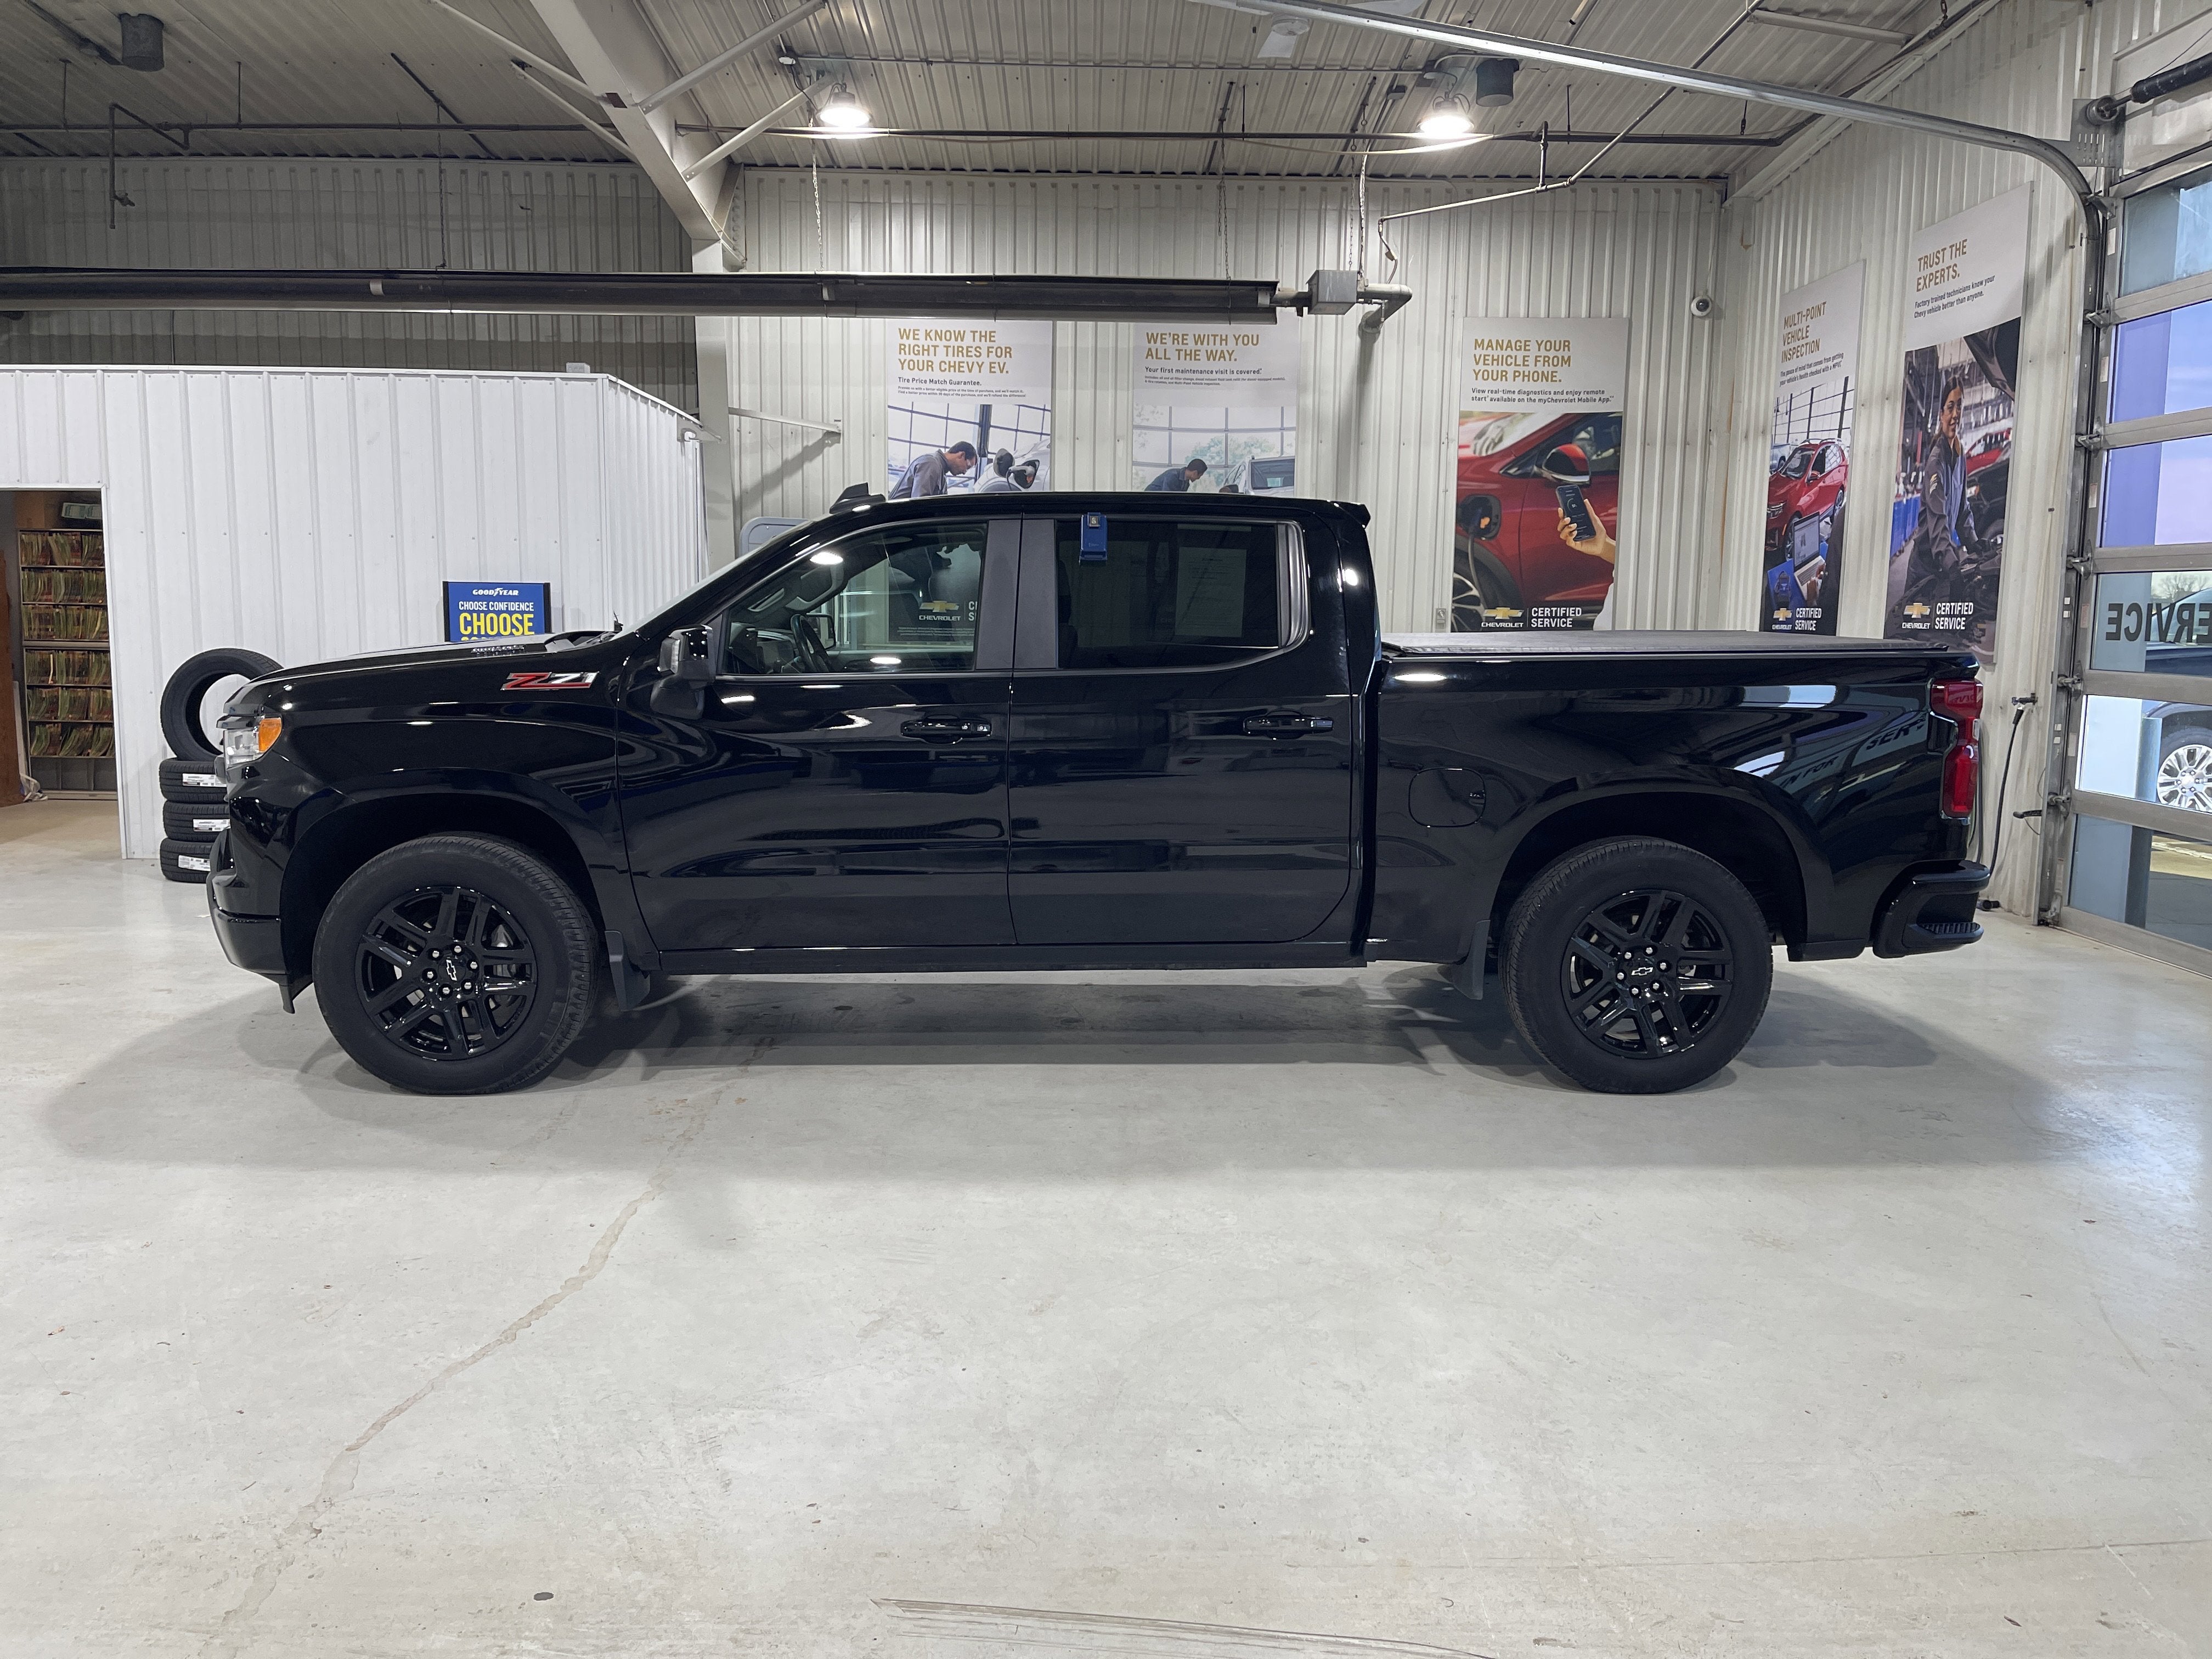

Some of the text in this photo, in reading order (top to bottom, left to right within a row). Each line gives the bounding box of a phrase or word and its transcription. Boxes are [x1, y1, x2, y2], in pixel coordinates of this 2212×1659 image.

[1918, 239, 1967, 272] TRUST THE
[1916, 263, 1960, 292] EXPERTS.
[1915, 275, 1995, 309] Factory trained technicians know your
[1914, 290, 1984, 318] Chevy vehicle better than anyone.
[1784, 301, 1826, 330] MULTI-POINT
[898, 328, 996, 343] WE KNOW THE
[1146, 332, 1260, 347] WE'RE WITH YOU
[1783, 325, 1809, 346] VEHICLE
[899, 343, 1013, 358] RIGHT TIRES FOR
[1474, 338, 1571, 352] MANAGE YOUR
[1781, 338, 1820, 363] INSPECTION
[1145, 348, 1238, 362] ALL THE WAY.
[1474, 354, 1571, 367] VEHICLE FROM
[898, 359, 1009, 374] YOUR CHEVY EV.
[1473, 369, 1562, 382] YOUR PHONE.
[472, 588, 519, 597] GOODYEAR
[459, 601, 534, 611] CHOOSE CONFIDENCE
[1531, 607, 1582, 617] CERTIFIED
[1796, 607, 1822, 619] CERTIFIED
[1936, 602, 1974, 615] CERTIFIED
[459, 612, 535, 636] CHOOSE
[1531, 618, 1573, 628] SERVICE
[1795, 619, 1817, 631] SERVICE
[1934, 617, 1966, 630] SERVICE
[500, 671, 600, 691] Z71
